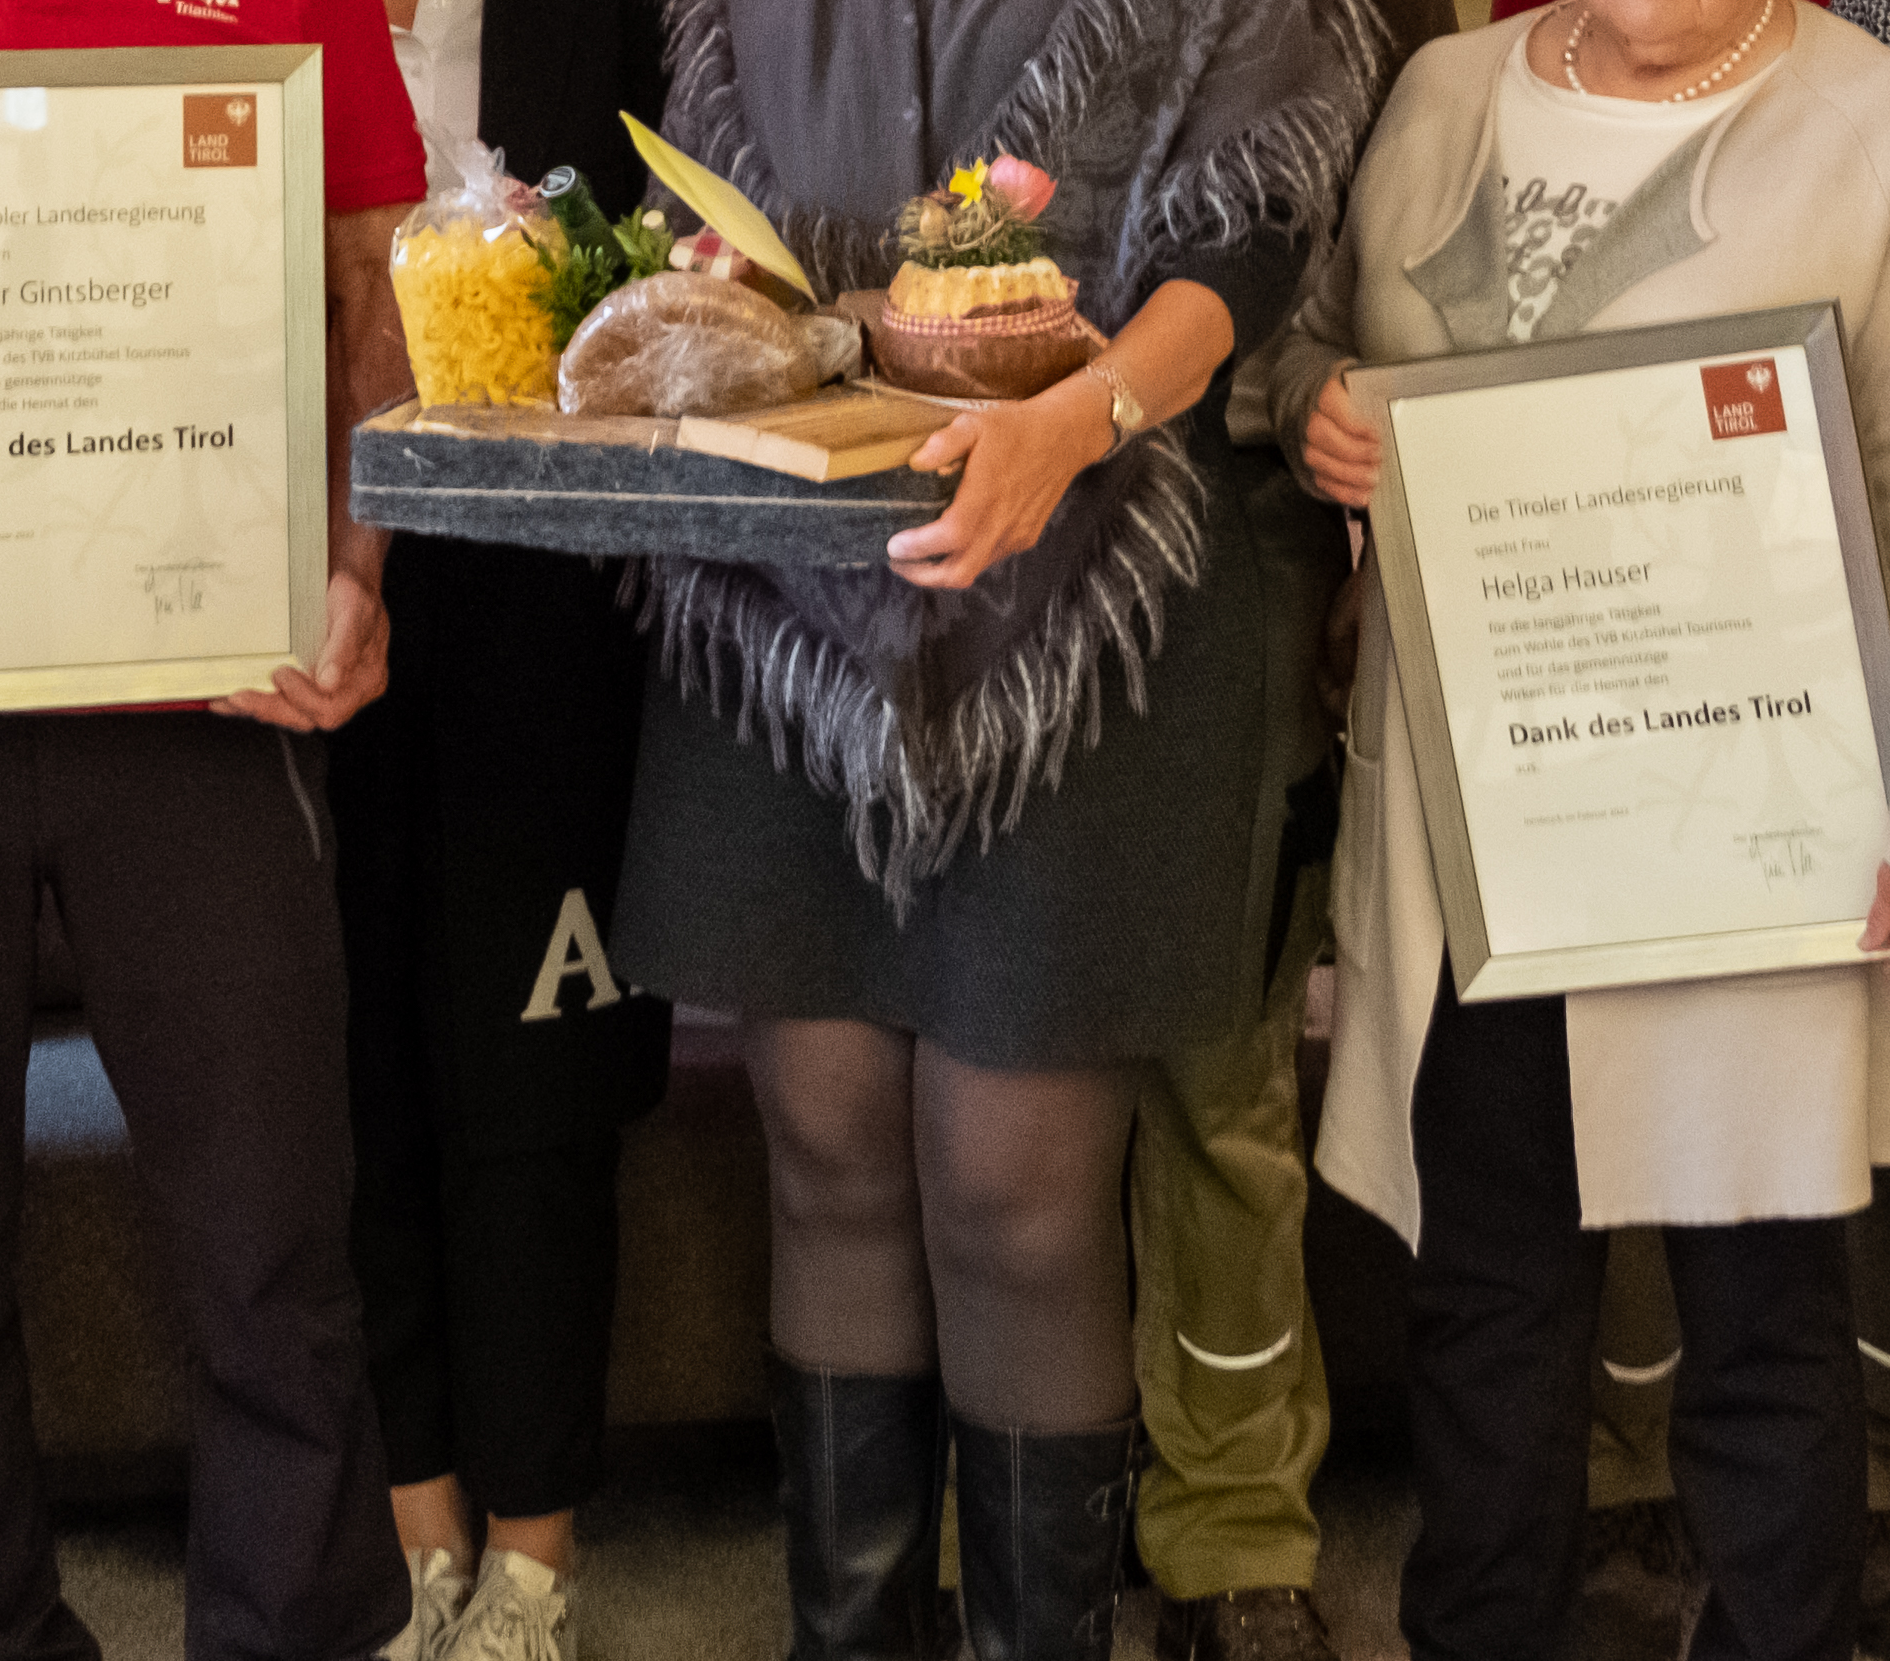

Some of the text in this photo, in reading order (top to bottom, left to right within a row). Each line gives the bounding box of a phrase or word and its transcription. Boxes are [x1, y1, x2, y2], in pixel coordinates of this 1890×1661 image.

[189, 133, 229, 147] LAND
[189, 147, 230, 163] TIROL
[36, 203, 206, 229] Landesregierung
[19, 277, 173, 308] Gintsberger
[49, 325, 103, 341] Tätigkeit
[3, 351, 26, 365] des
[31, 350, 55, 363] TVB
[59, 349, 120, 362] Kitzbühel
[125, 347, 191, 359] Tourismus
[5, 373, 103, 389] gemeinnützige
[22, 397, 69, 409] Heimat
[73, 397, 99, 408] den
[1713, 401, 1754, 422] LAND
[1716, 415, 1758, 434] TIROL
[7, 431, 56, 457] des
[66, 427, 163, 455] Landes
[173, 423, 235, 450] Tirol
[1467, 474, 1745, 524] Die Tiroler Landesregierung
[1521, 538, 1550, 552] Frau
[1482, 561, 1651, 602] Helga Hauser
[1488, 603, 1661, 634] für die langjährige Tätigkeit
[1493, 616, 1753, 657] zum Wohle des TVB Kitzbühel Tourismus
[1497, 649, 1669, 680] und für das gemeinnützige
[1500, 673, 1669, 703] Wirken für die Heimat den
[1508, 688, 1812, 748] Dank des Landes Tirol
[520, 888, 621, 1022] A
